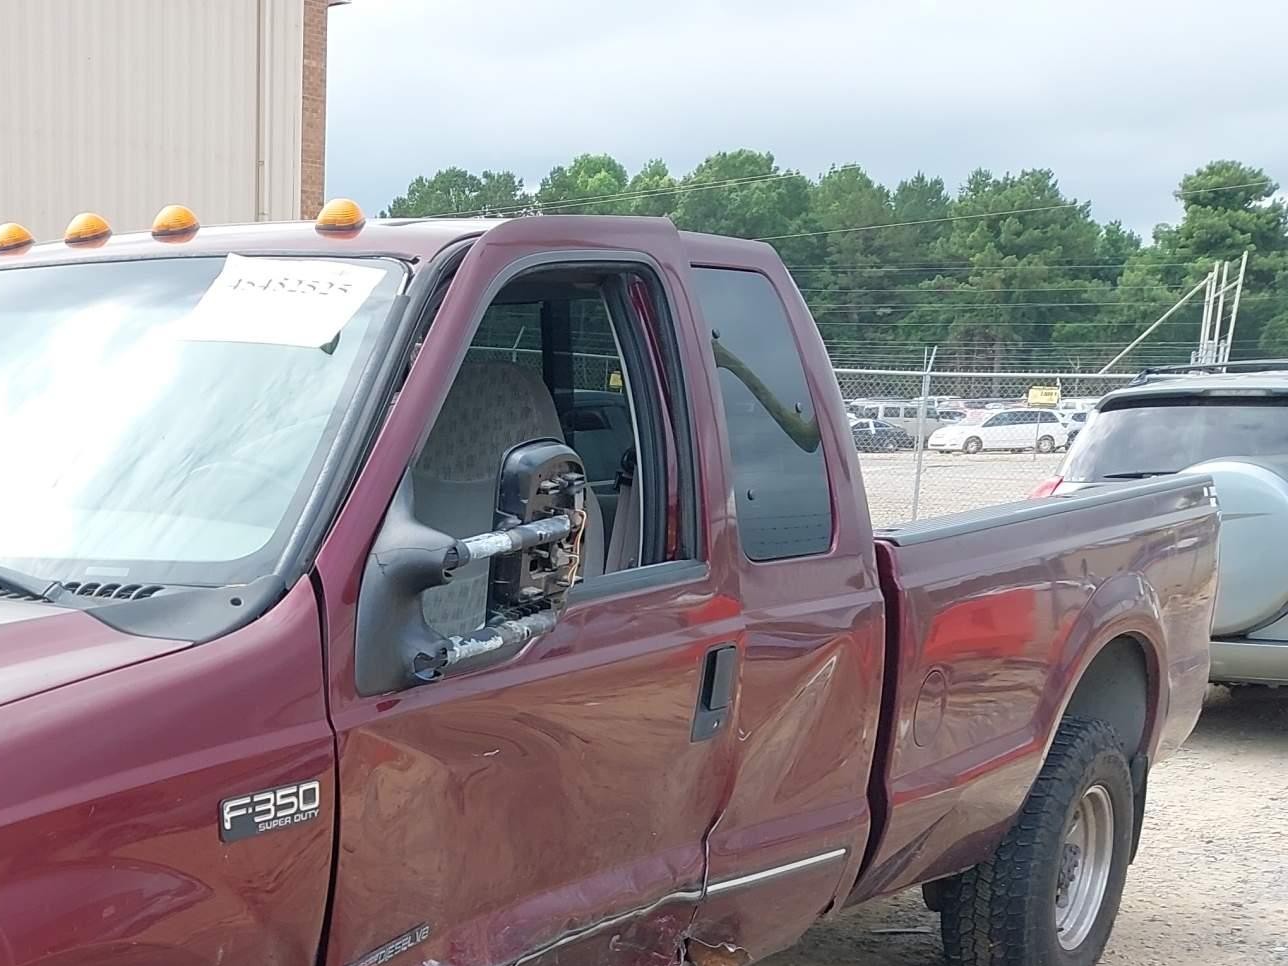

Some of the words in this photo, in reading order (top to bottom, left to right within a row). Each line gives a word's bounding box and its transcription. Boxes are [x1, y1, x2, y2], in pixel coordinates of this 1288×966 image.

[223, 780, 320, 830] F-350
[258, 814, 292, 832] SUPER
[294, 808, 320, 825] DUTY
